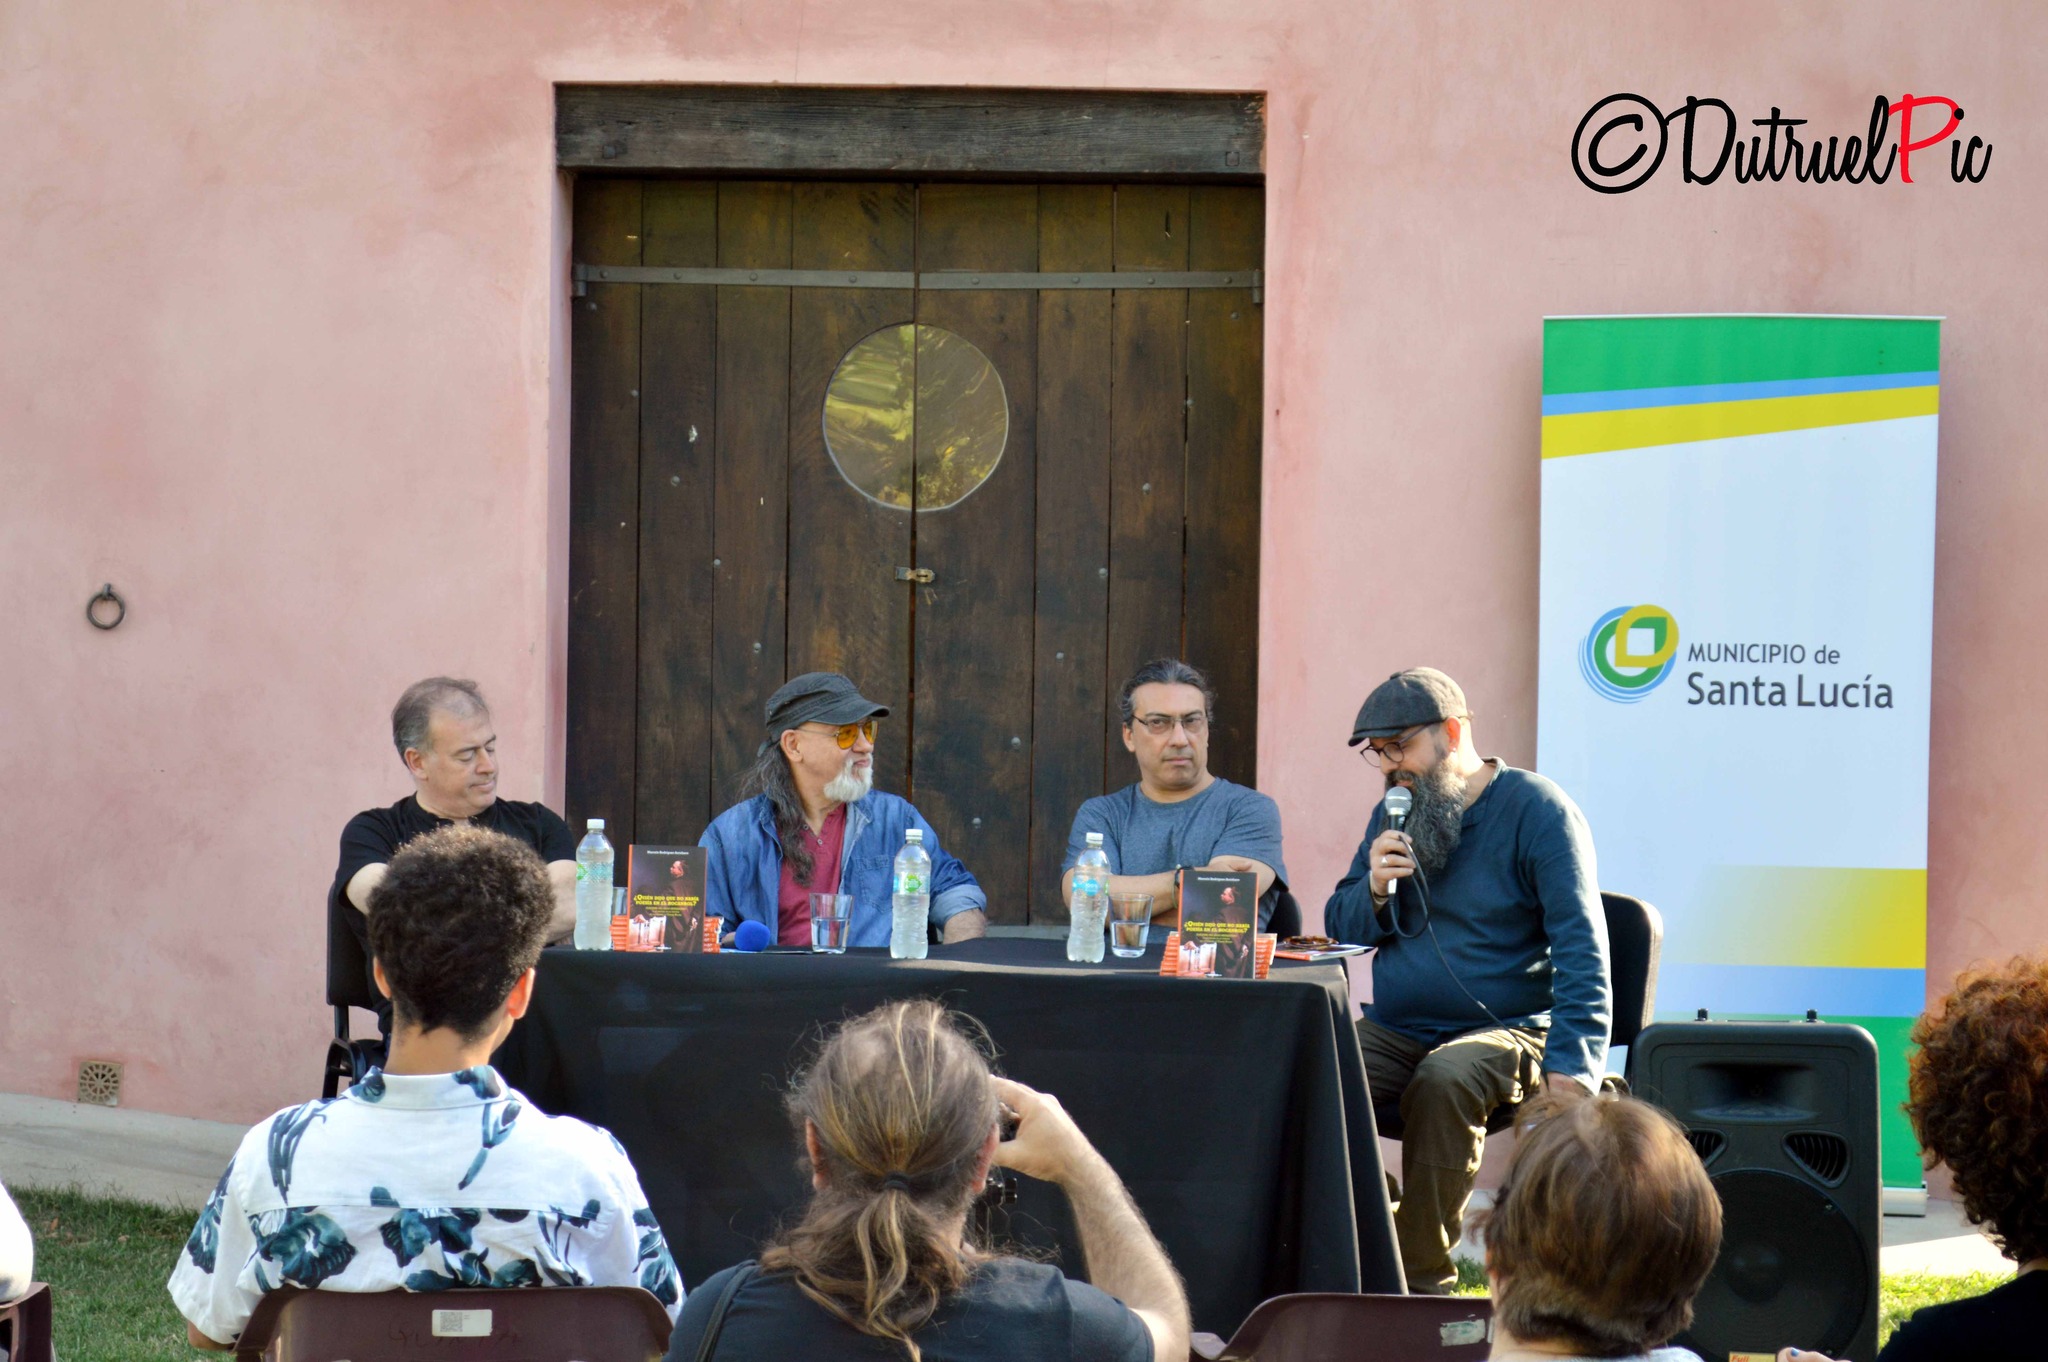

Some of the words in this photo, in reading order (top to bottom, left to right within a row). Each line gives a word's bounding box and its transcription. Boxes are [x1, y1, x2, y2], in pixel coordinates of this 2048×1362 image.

[1687, 643, 1806, 664] MUNICIPIO
[1814, 645, 1841, 664] de
[1687, 671, 1787, 707] Santa
[1796, 674, 1894, 709] Lucía
